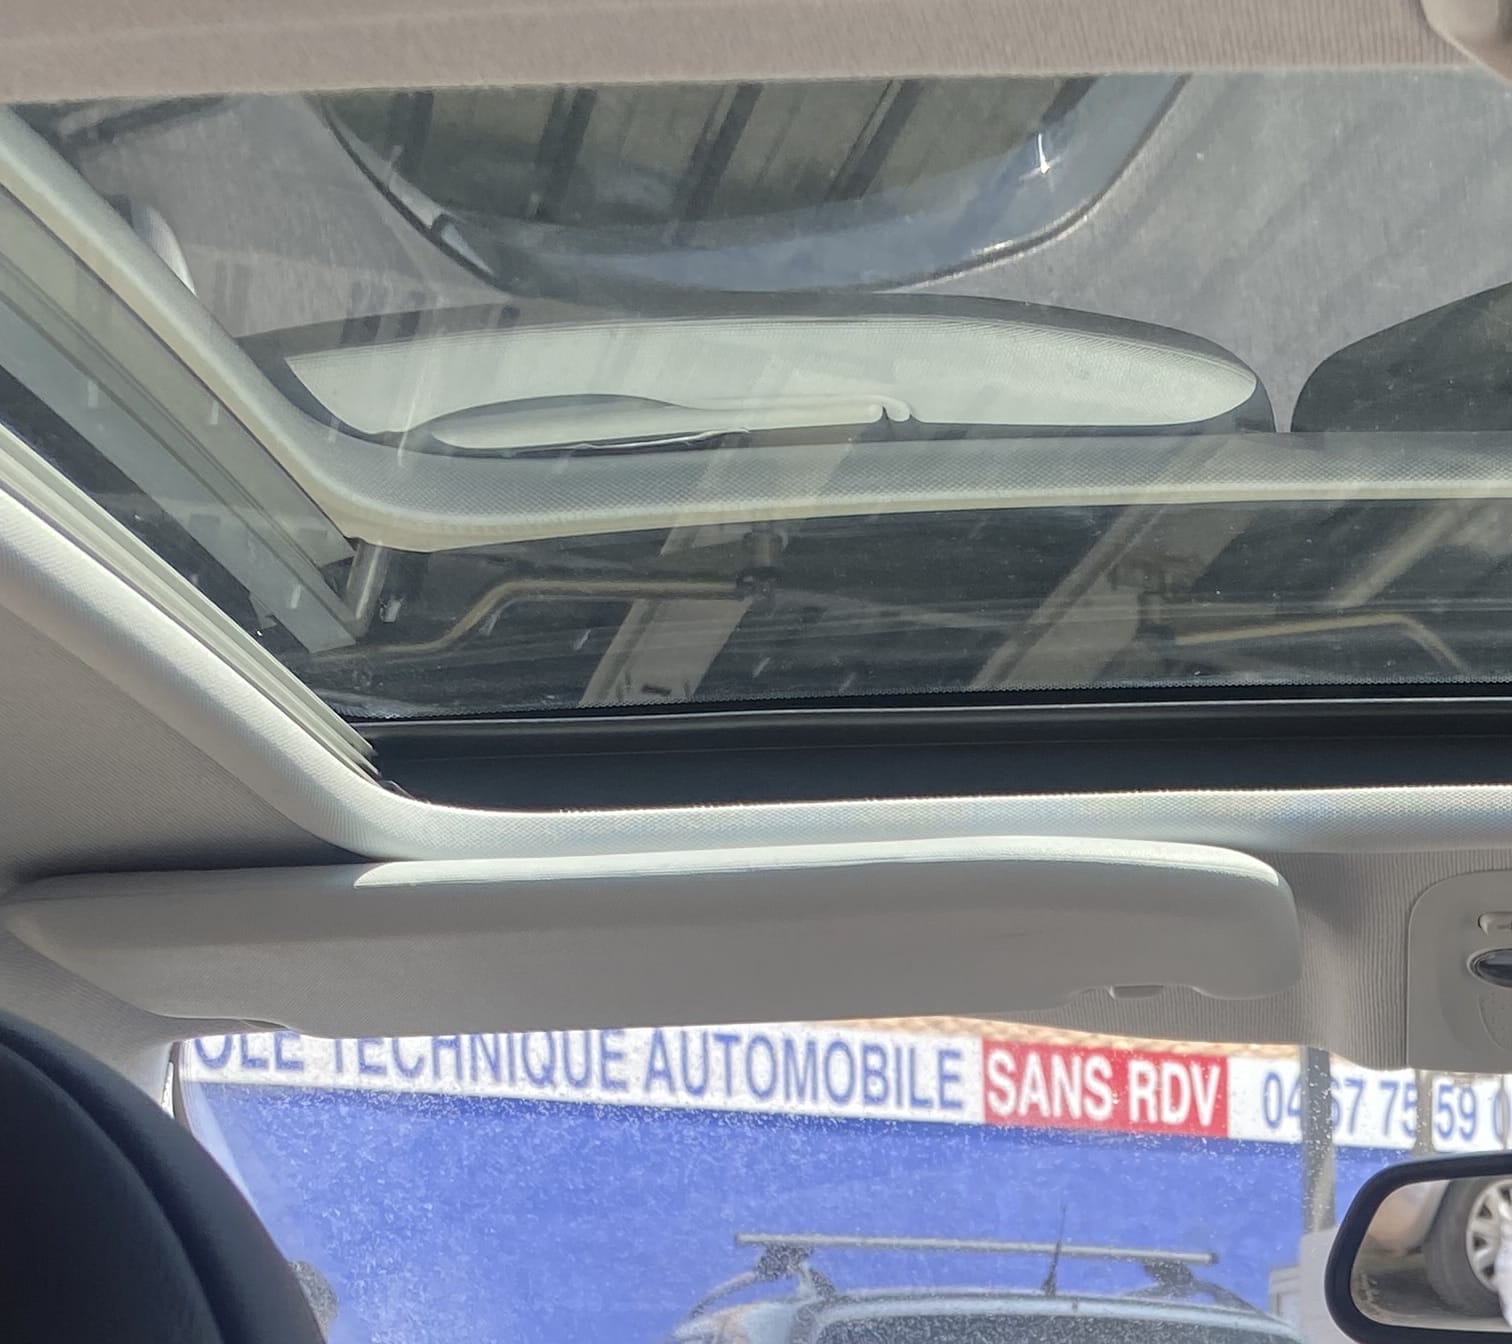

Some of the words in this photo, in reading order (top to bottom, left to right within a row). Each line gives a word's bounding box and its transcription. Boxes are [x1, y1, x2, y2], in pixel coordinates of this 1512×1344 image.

[643, 1027, 963, 1111] AUTOMOBILE
[986, 1050, 1114, 1122] SANS
[1127, 1056, 1222, 1128] RDV
[1432, 1083, 1478, 1143] 59
